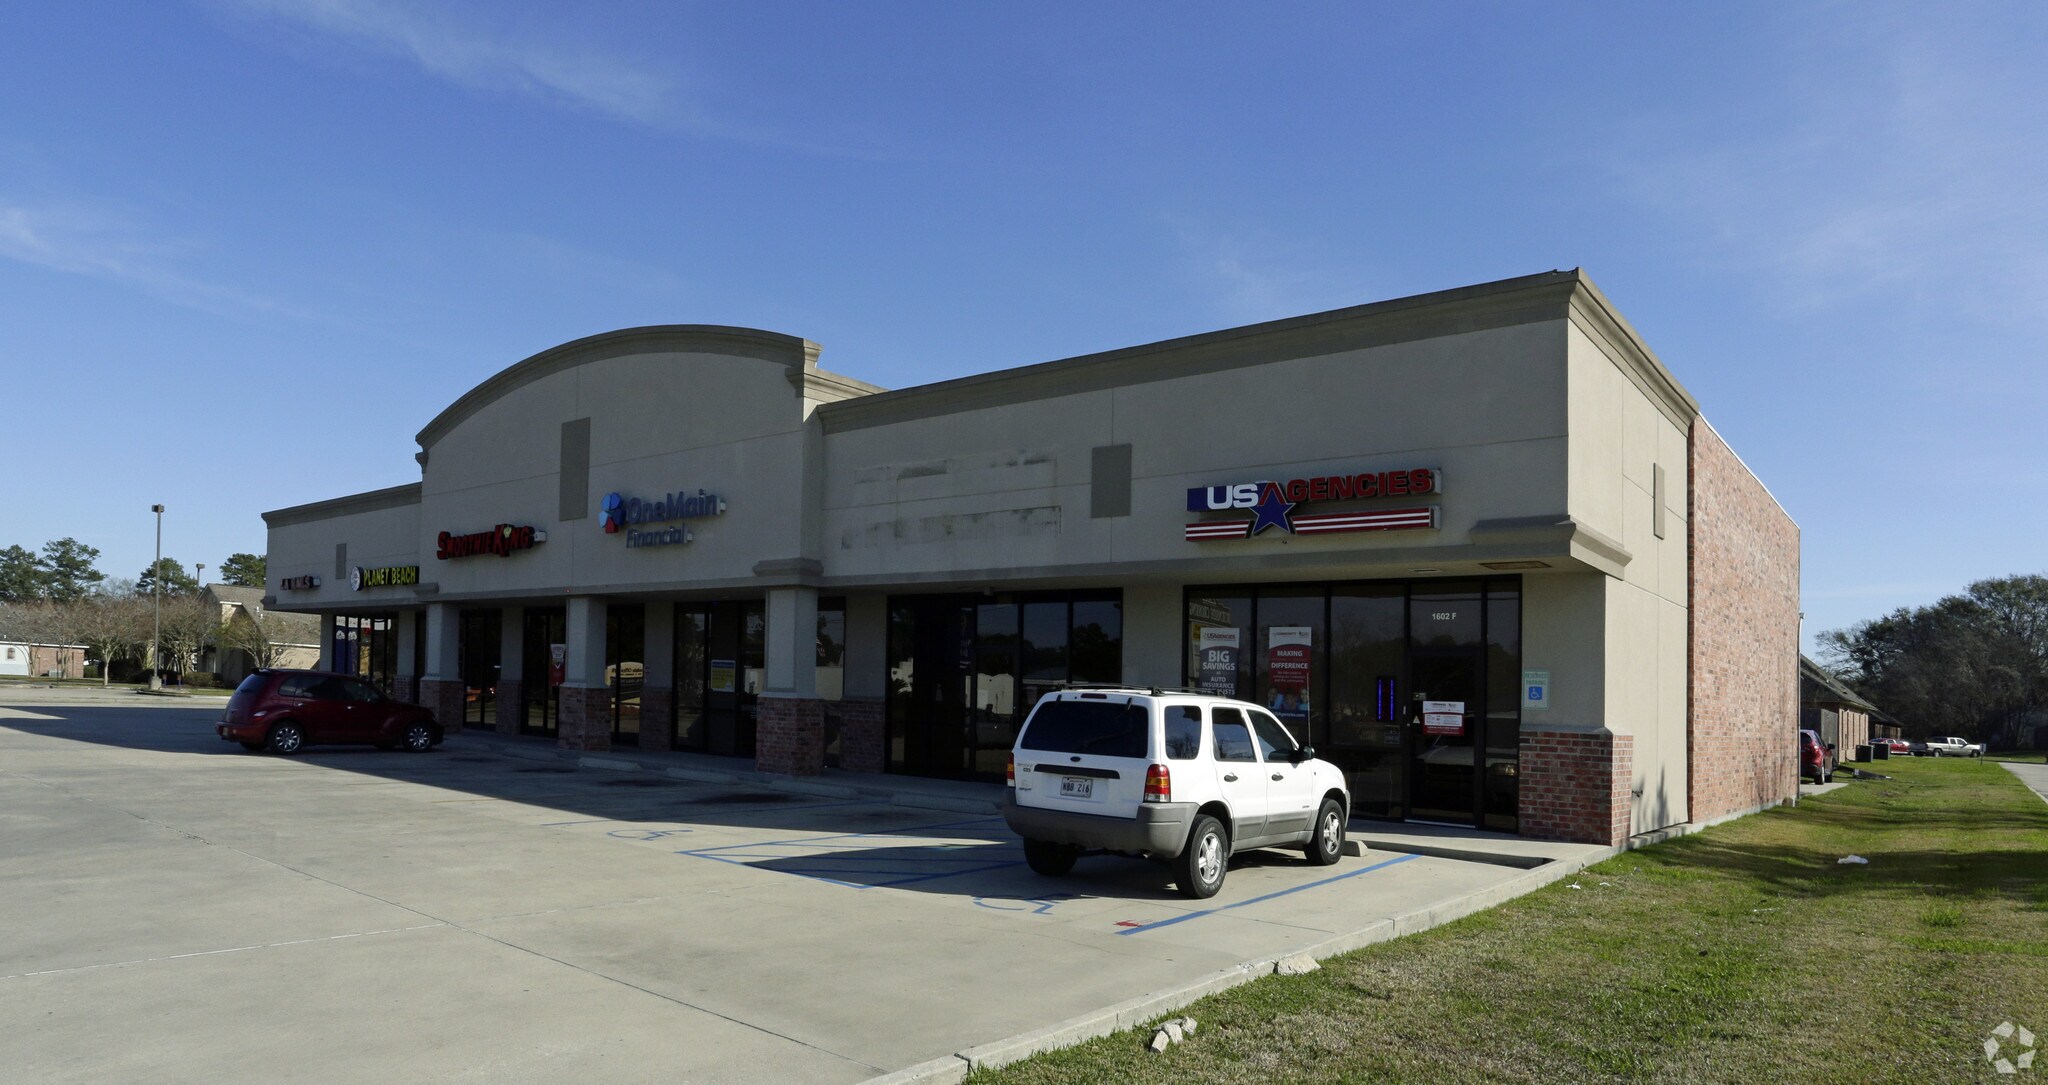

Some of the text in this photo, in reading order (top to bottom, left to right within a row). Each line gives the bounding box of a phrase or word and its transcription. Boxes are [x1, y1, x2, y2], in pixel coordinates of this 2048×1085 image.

[625, 488, 720, 524] OneMain
[626, 523, 688, 549] Financial
[437, 531, 495, 560] SMOOTHIE
[363, 566, 416, 588] PLANET BEACH
[1431, 612, 1457, 620] 1602 F
[1208, 650, 1230, 662] BIG
[1202, 662, 1236, 671] SAVINGS
[1271, 662, 1308, 670] DIFFERENCE
[1201, 681, 1235, 689] INSURANCE
[1077, 784, 1090, 793] 216
